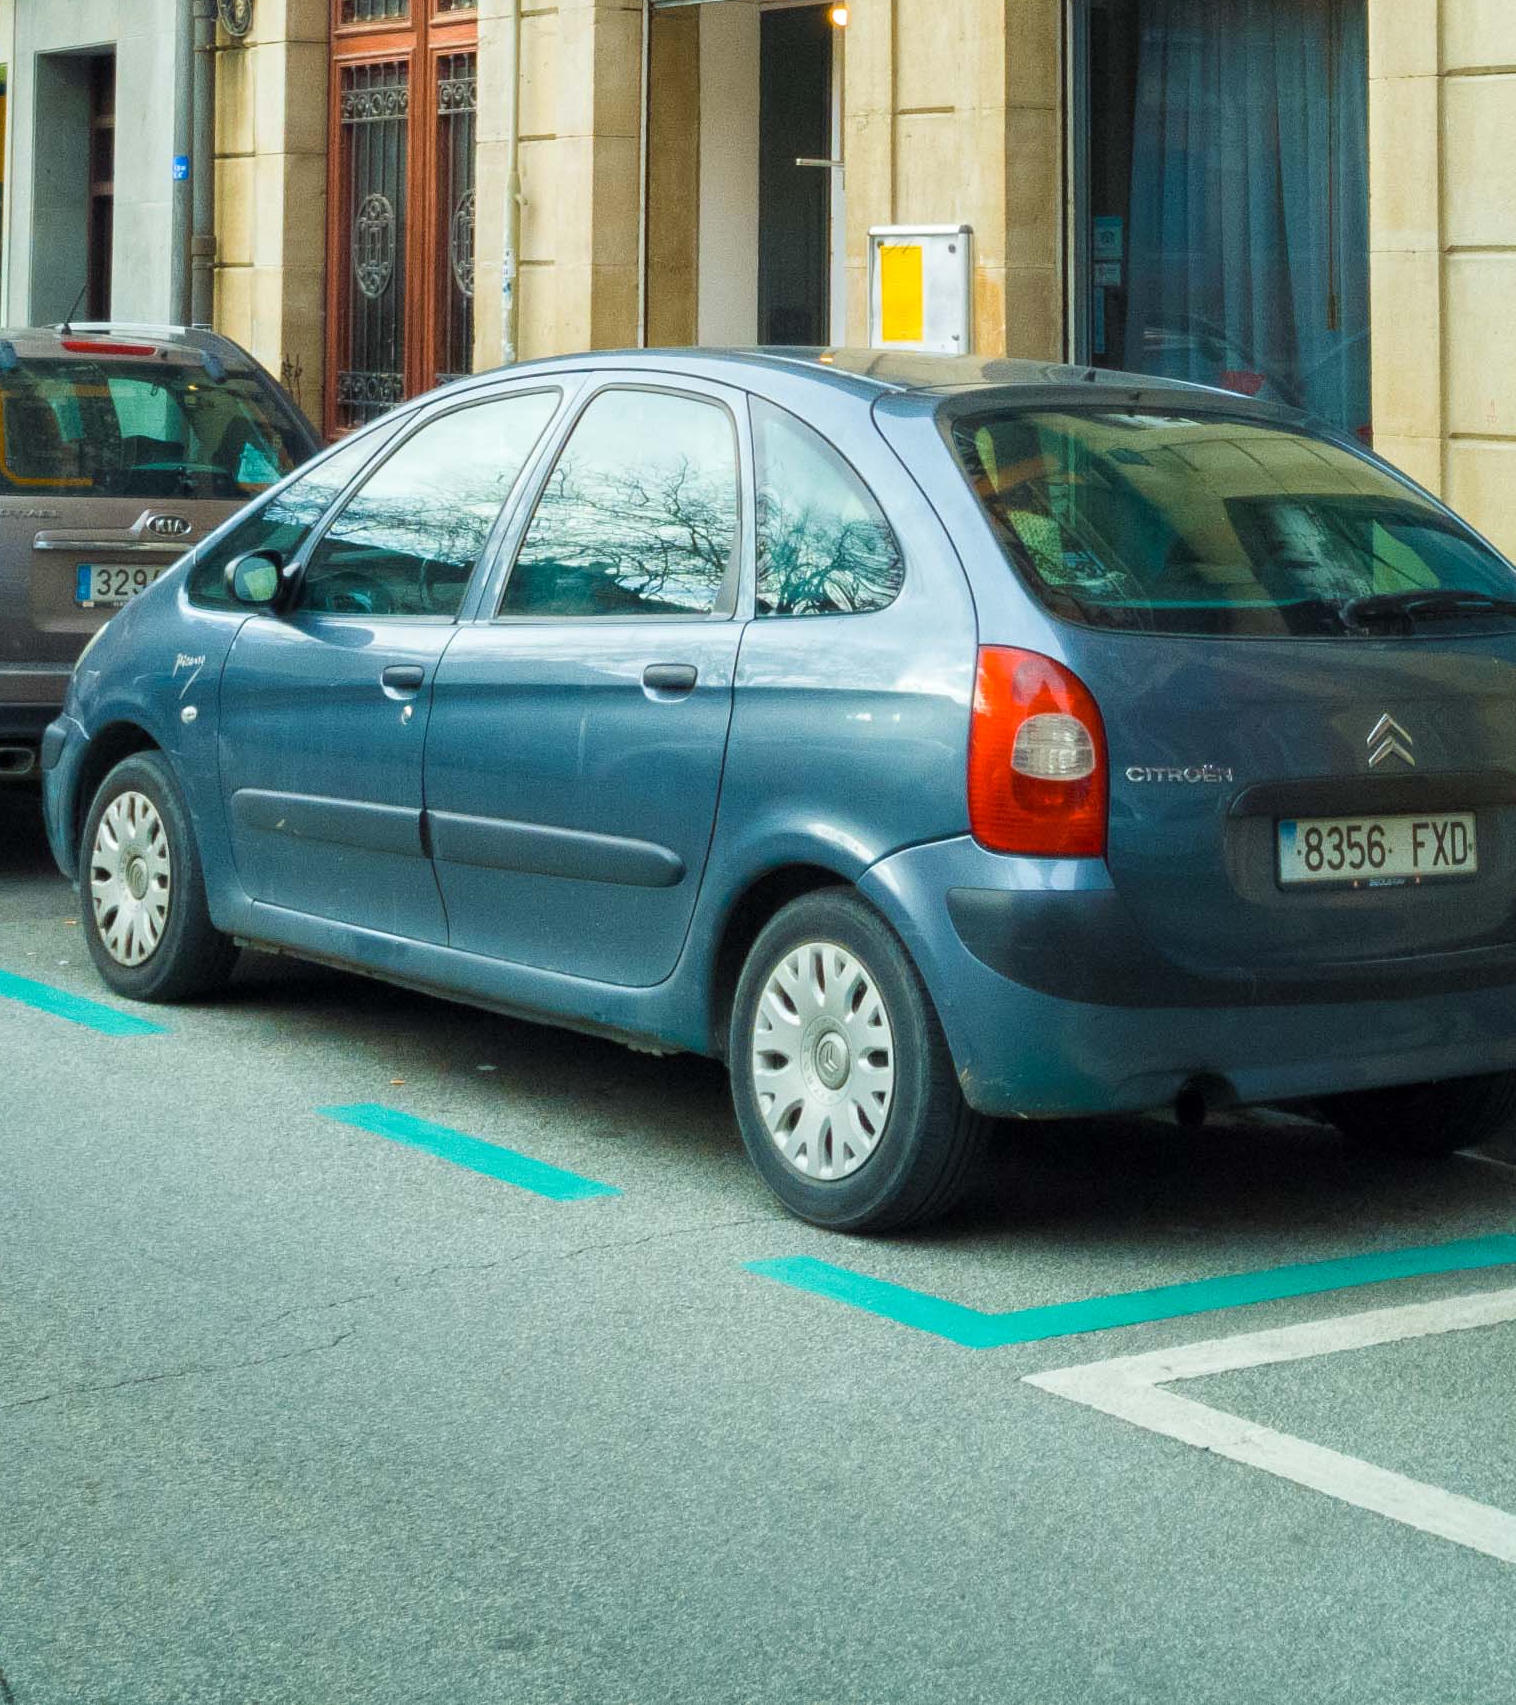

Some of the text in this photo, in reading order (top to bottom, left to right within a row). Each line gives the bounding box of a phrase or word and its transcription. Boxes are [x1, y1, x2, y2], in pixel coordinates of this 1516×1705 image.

[155, 518, 185, 534] KIA
[1125, 763, 1234, 783] CITROËN
[1304, 820, 1468, 872] 8356 FXD
